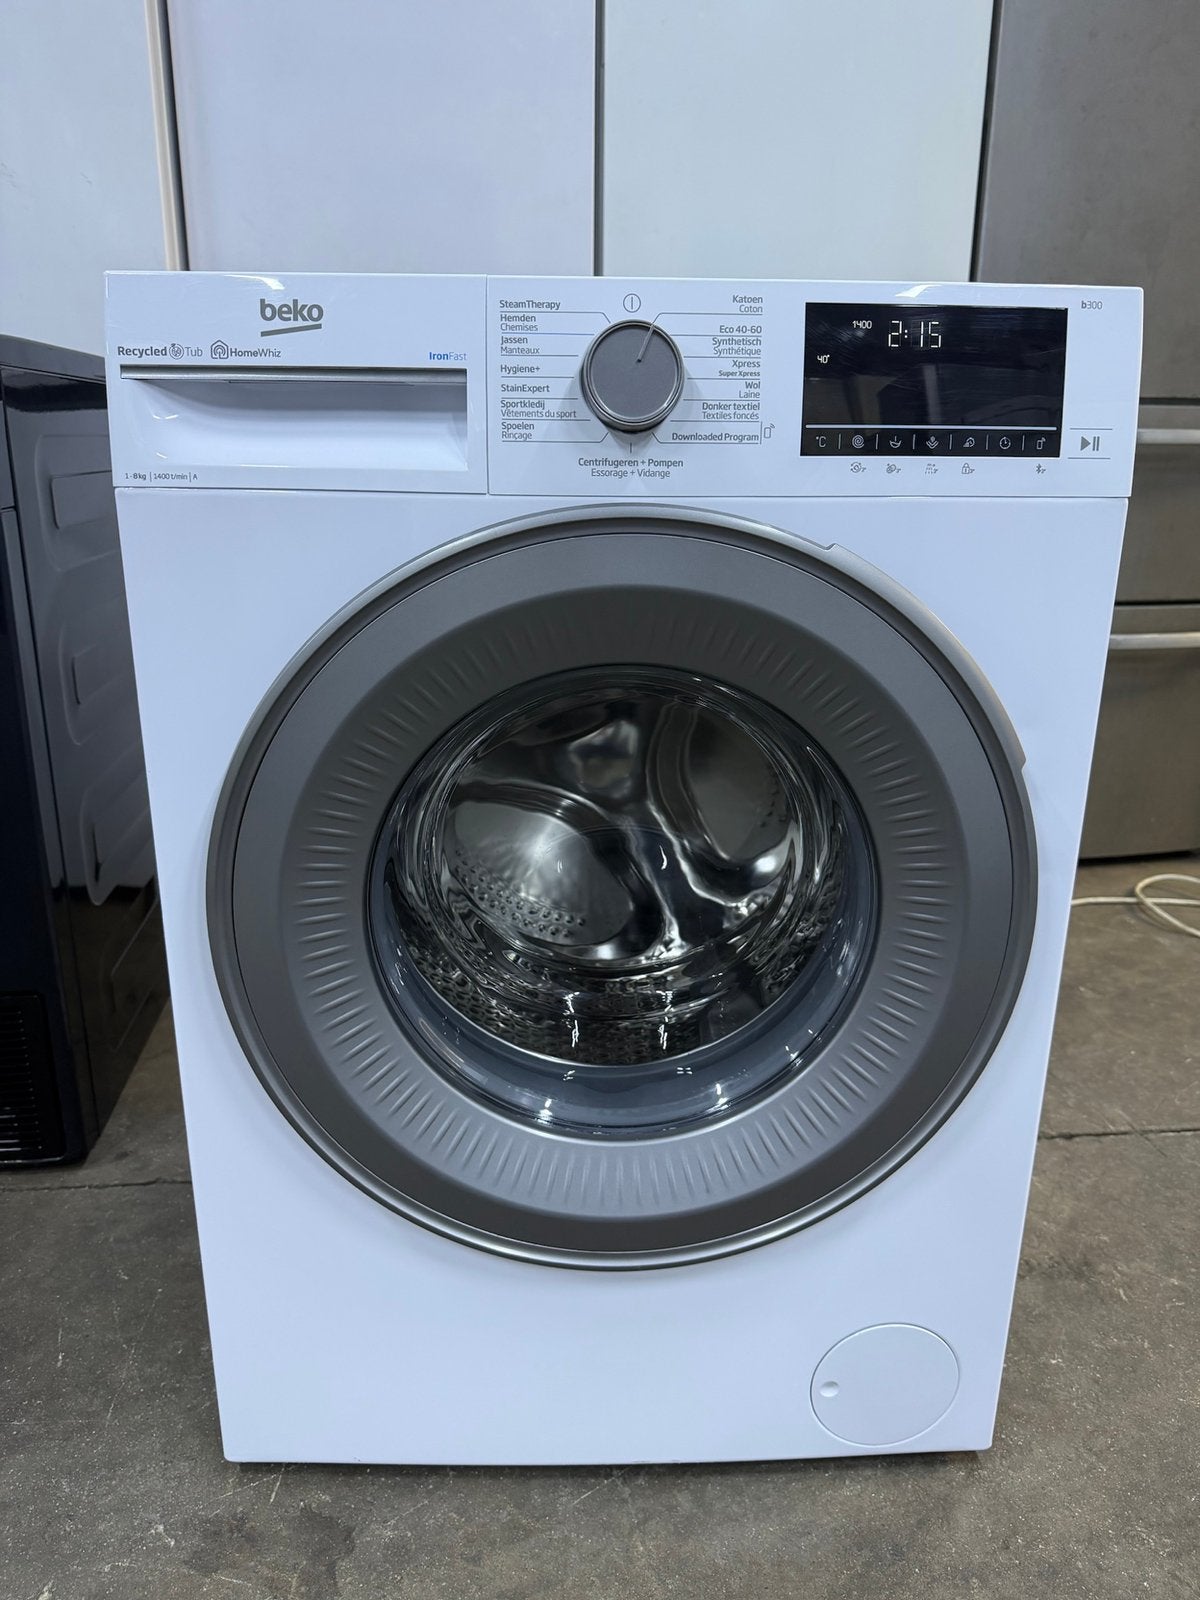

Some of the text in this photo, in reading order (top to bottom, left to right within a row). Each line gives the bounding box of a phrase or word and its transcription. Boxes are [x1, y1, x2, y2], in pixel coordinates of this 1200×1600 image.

[732, 295, 764, 304] Katoen
[260, 298, 324, 322] beko
[499, 300, 561, 311] SteamTherapy
[739, 305, 763, 314] Coton
[1081, 301, 1103, 310] b300
[500, 314, 536, 323] Hemden
[500, 323, 538, 332] Chemises
[719, 325, 763, 334] Eco 40-60
[852, 320, 873, 330] 1400
[888, 320, 942, 348] 2:15
[500, 336, 528, 345] Jassen
[712, 337, 763, 348] Synthetisch
[117, 346, 203, 359] Recycled Tub
[229, 348, 281, 358] HomeWhiz
[500, 346, 540, 355] Manteaux
[713, 346, 762, 357] Synthétique
[428, 352, 467, 362] IronFast
[732, 360, 761, 370] Xpress
[500, 365, 541, 376] Hygiene+
[501, 384, 550, 393] StainExpert
[745, 381, 761, 390] Wol
[739, 390, 760, 399] Laine
[501, 400, 545, 410] Sportkledij
[702, 402, 761, 411] Donker textiel
[501, 409, 577, 420] Vêtements du sport
[702, 411, 760, 420] Textiles foncés
[501, 421, 535, 431] Spoelen
[501, 431, 533, 441] Rinçage
[671, 432, 760, 443] Downloaded Program
[578, 458, 639, 468] Centrifugeren
[647, 459, 684, 468] Pompen
[591, 468, 628, 478] Essorage
[637, 469, 671, 479] Vidange
